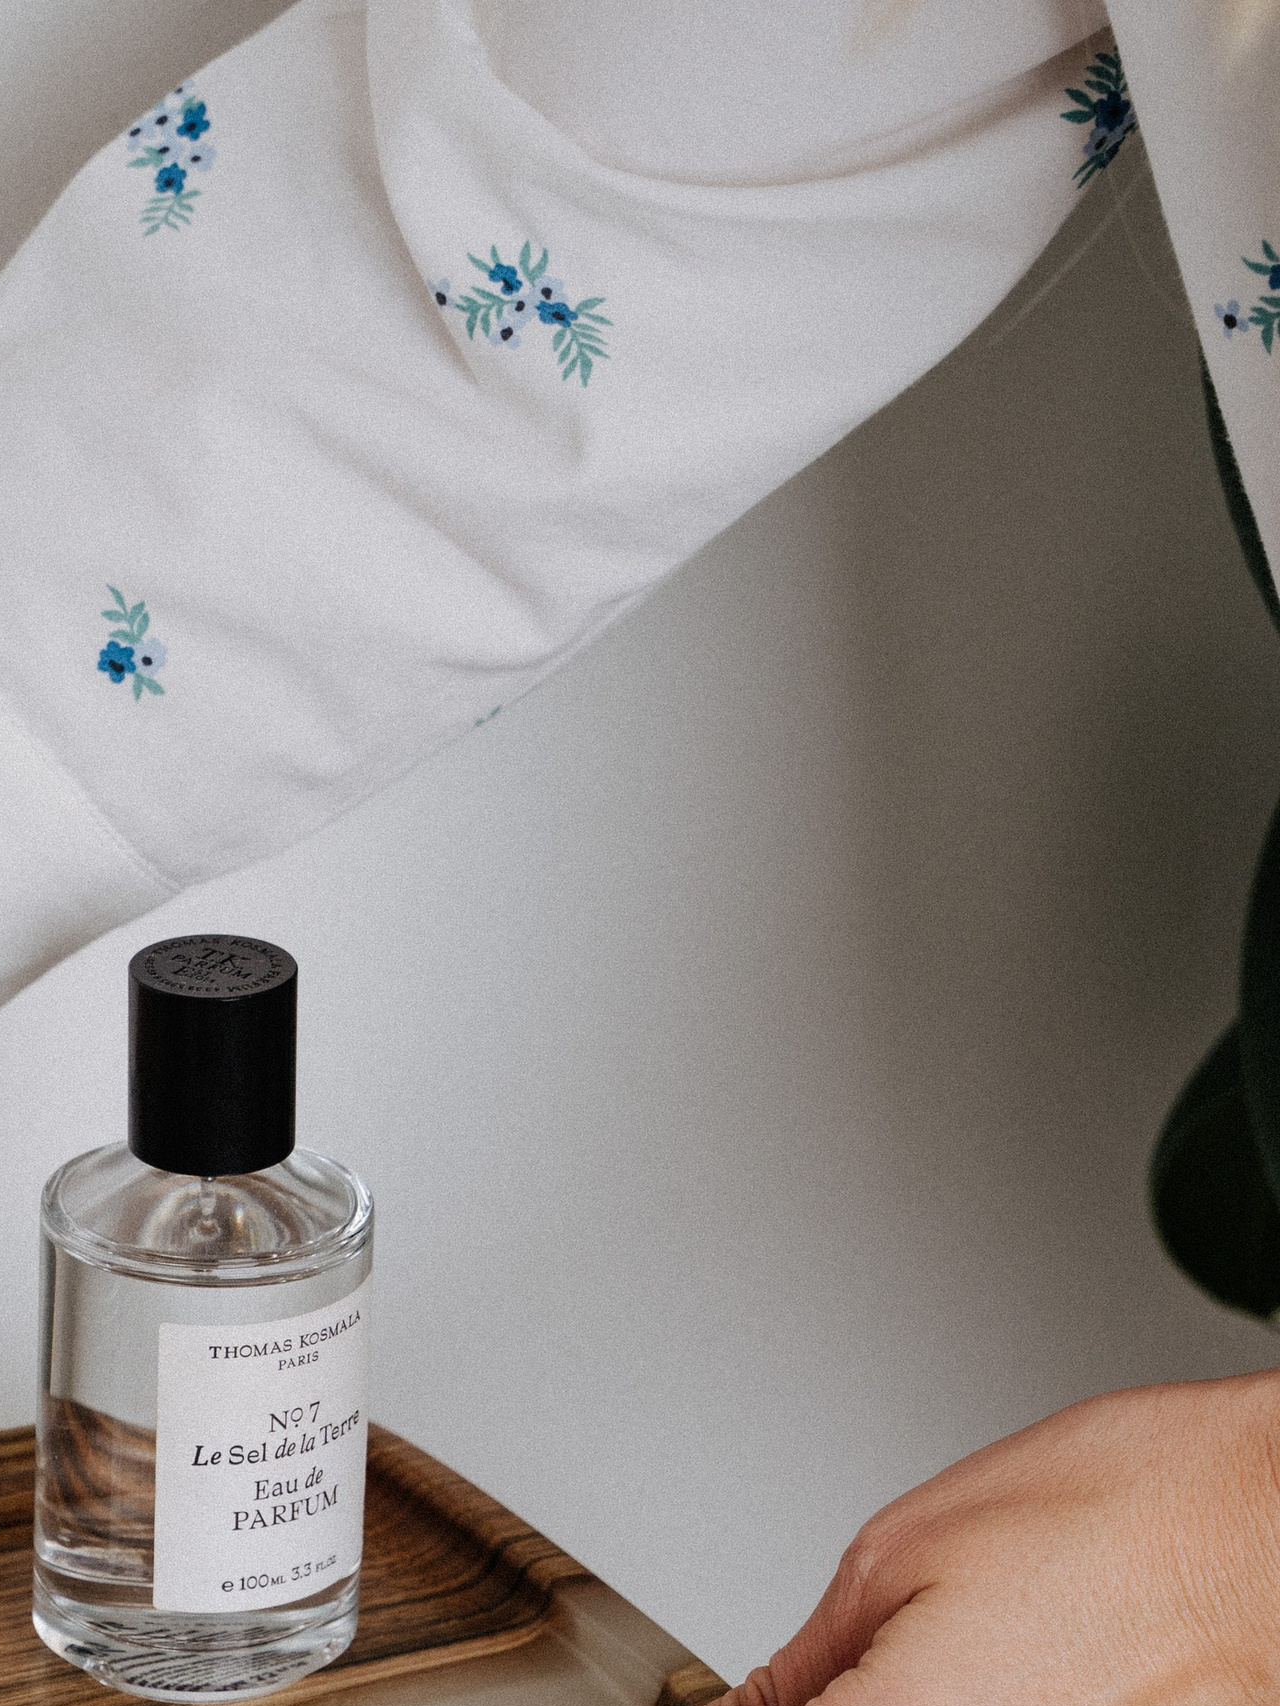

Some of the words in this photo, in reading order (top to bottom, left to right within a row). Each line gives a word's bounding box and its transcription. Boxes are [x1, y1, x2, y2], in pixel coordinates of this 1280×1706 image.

[171, 954, 252, 979] PARFUM
[209, 1339, 292, 1359] THOMAS
[299, 1310, 361, 1349] KOSMALA
[278, 1351, 320, 1371] PARIS
[309, 1401, 321, 1423] 7
[191, 1445, 222, 1466] Le
[228, 1442, 268, 1466] Sel
[274, 1434, 297, 1460] de
[300, 1429, 317, 1452] la
[320, 1409, 361, 1446] Terre
[254, 1480, 299, 1502] Eau
[304, 1466, 324, 1489] de
[232, 1484, 339, 1531] PARFUM
[291, 1561, 312, 1581] 3.3
